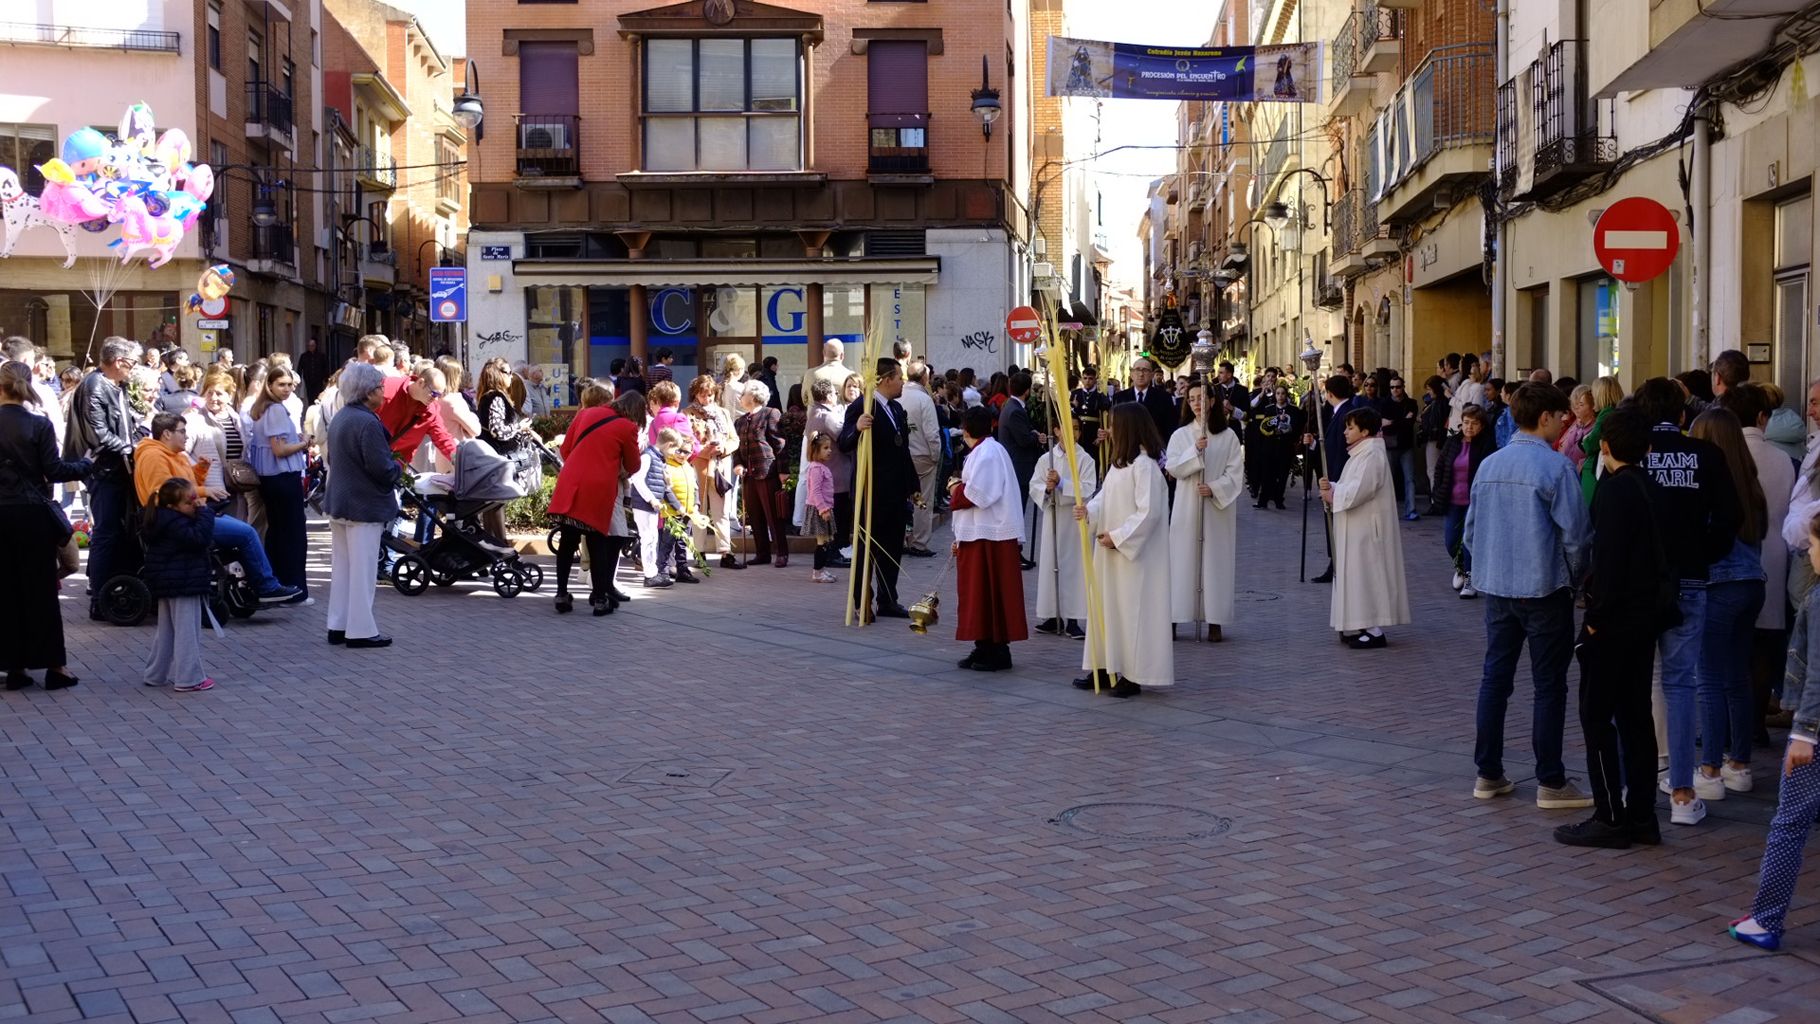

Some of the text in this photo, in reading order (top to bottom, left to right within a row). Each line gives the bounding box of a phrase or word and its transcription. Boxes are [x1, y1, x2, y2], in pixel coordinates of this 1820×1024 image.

[1141, 71, 1175, 79] PROCESIÓN
[651, 283, 808, 335] C & G
[961, 331, 998, 354] NASK
[1647, 452, 1699, 469] EAM
[1648, 469, 1700, 489] ARL
